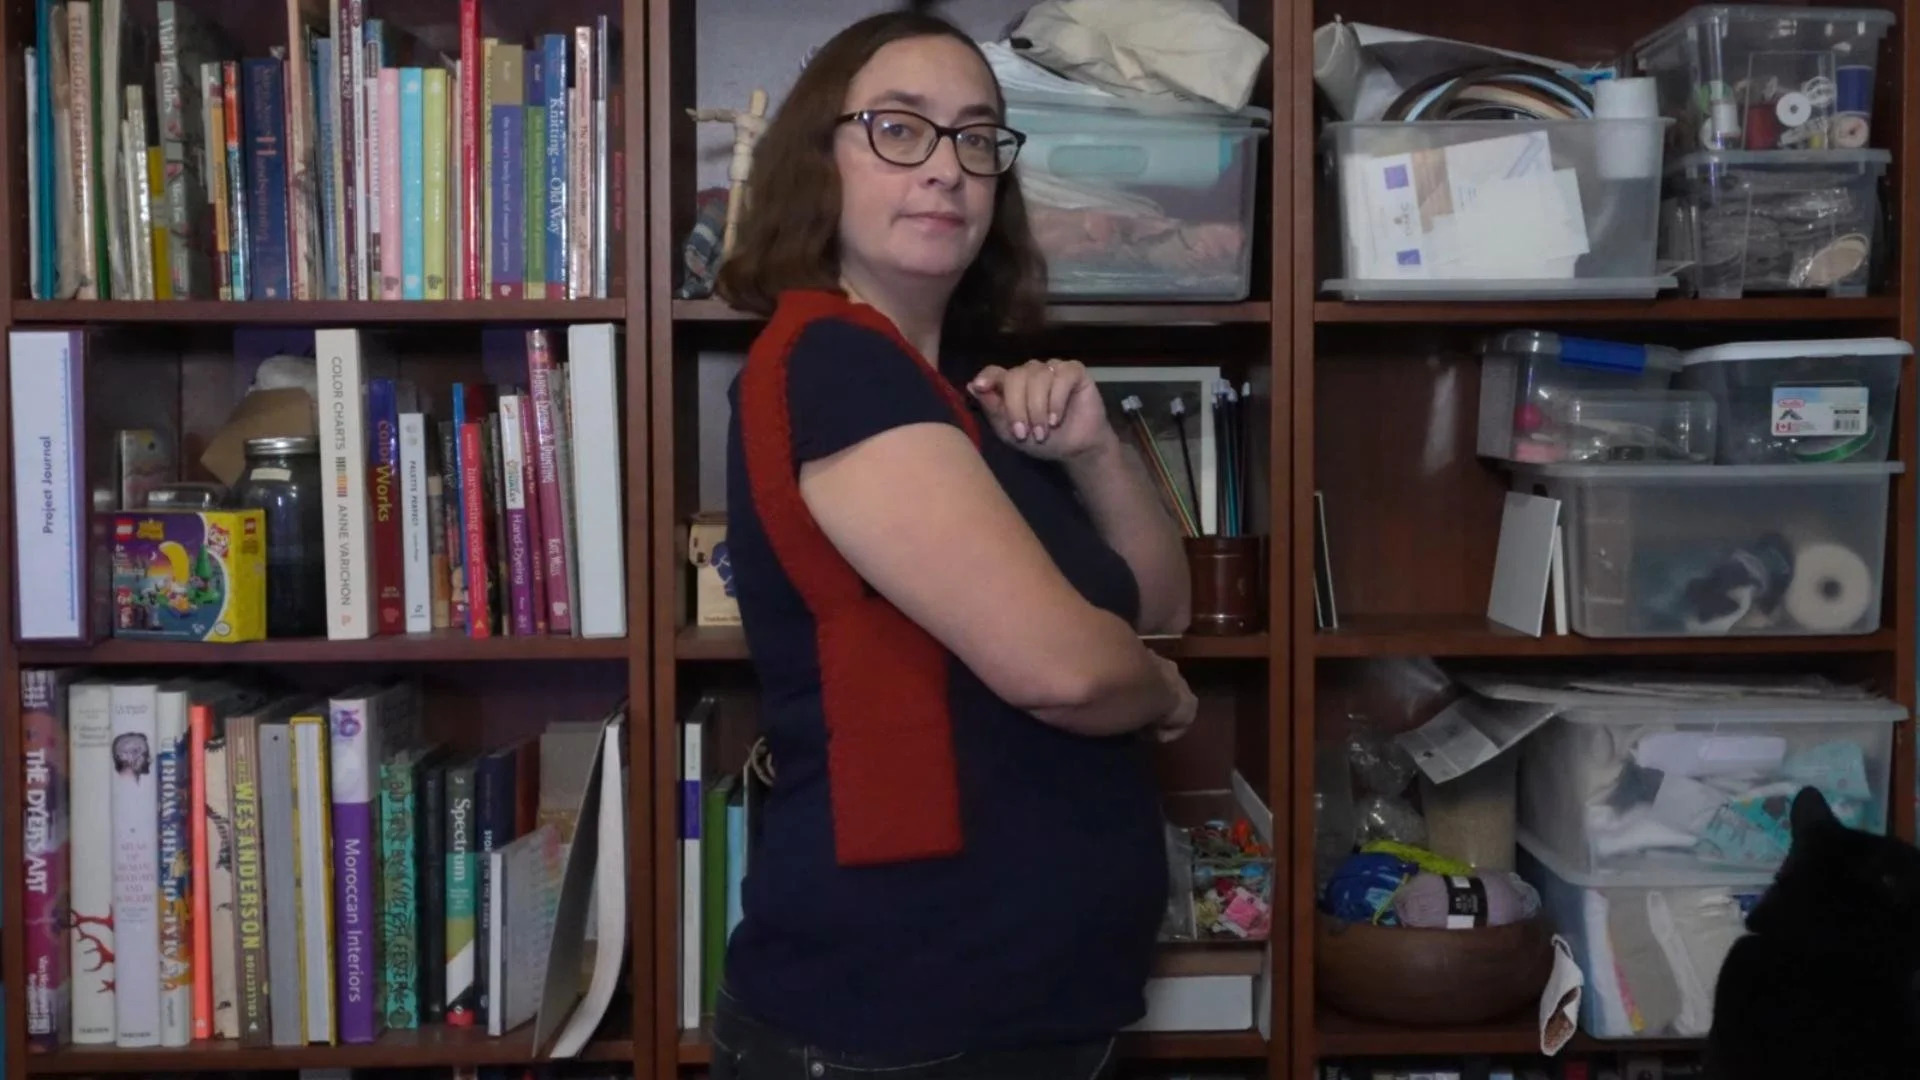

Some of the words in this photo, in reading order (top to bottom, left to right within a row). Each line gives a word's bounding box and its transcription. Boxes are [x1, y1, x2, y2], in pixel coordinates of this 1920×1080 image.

[159, 17, 174, 53] Wild
[161, 52, 178, 113] Textiles
[547, 98, 562, 156] Knitting
[550, 177, 562, 207] Old
[547, 207, 563, 236] Way
[331, 356, 344, 398] COLOR
[333, 401, 346, 450] CHARTS
[39, 436, 53, 485] Journal
[409, 460, 418, 491] PALETTE
[42, 489, 56, 534] Project
[337, 504, 350, 540] ANNE
[411, 495, 420, 526] PERFECT
[466, 466, 482, 531] harvesting
[471, 532, 483, 562] color
[511, 514, 526, 585] Hand-Dyeing
[339, 541, 352, 606] VARICHON
[25, 748, 49, 784] THE
[161, 737, 178, 821] WORLD
[234, 781, 255, 829] WES
[163, 823, 178, 866] THE
[449, 797, 472, 881] Spectrum
[25, 855, 48, 895] ART
[238, 835, 260, 950] ANDERSON
[343, 838, 361, 924] Moroccan
[245, 955, 257, 1018] COLLECTION
[346, 929, 364, 1003] Interiors
